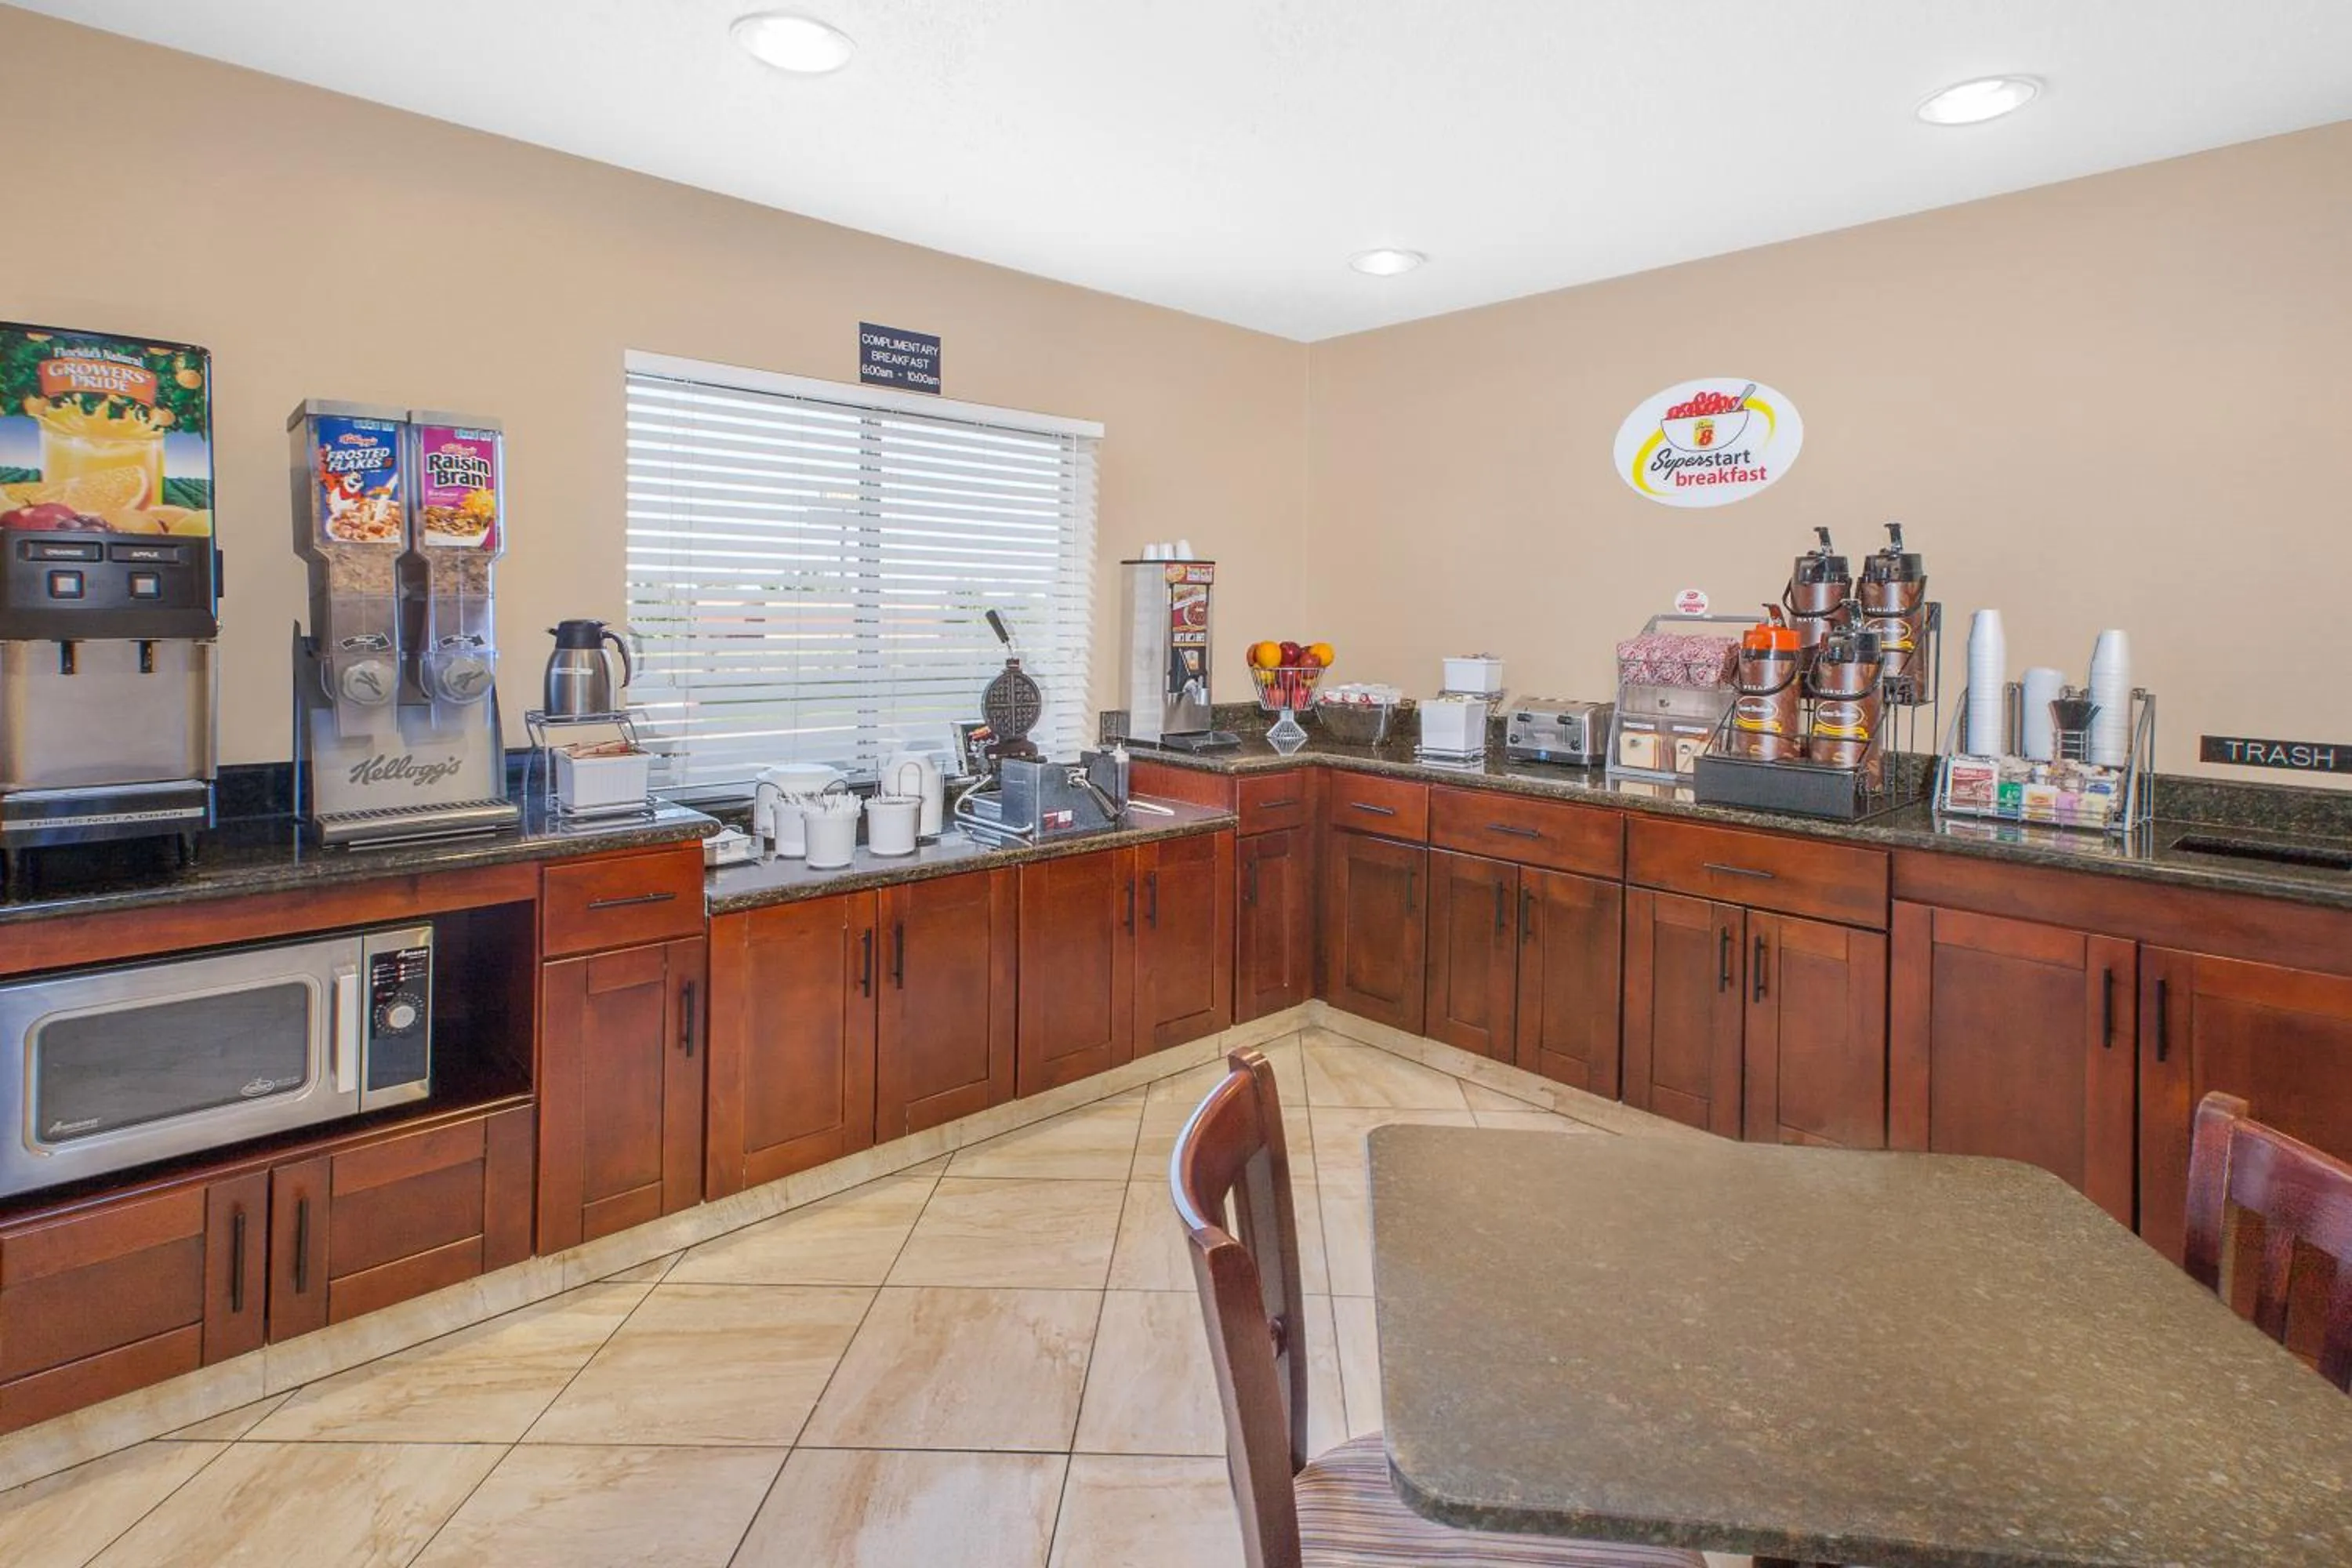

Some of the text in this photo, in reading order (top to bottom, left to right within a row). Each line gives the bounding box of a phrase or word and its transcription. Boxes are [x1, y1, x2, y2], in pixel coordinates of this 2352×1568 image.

[862, 333, 938, 356] COMPLIMENTARY
[103, 349, 143, 367] Natural
[871, 350, 929, 369] BREAKFAST
[862, 364, 893, 378] 6:00am
[71, 375, 129, 391] PRIDE
[1698, 429, 1714, 446] 8
[326, 448, 390, 462] FROSTED
[427, 453, 489, 475] Raisin
[328, 458, 383, 472] FLAKES
[1650, 448, 1751, 481] Superstart
[435, 470, 484, 486] Bran
[1675, 466, 1767, 487] breakfast
[2225, 741, 2335, 768] TRASH
[350, 753, 462, 786] Kellogg's
